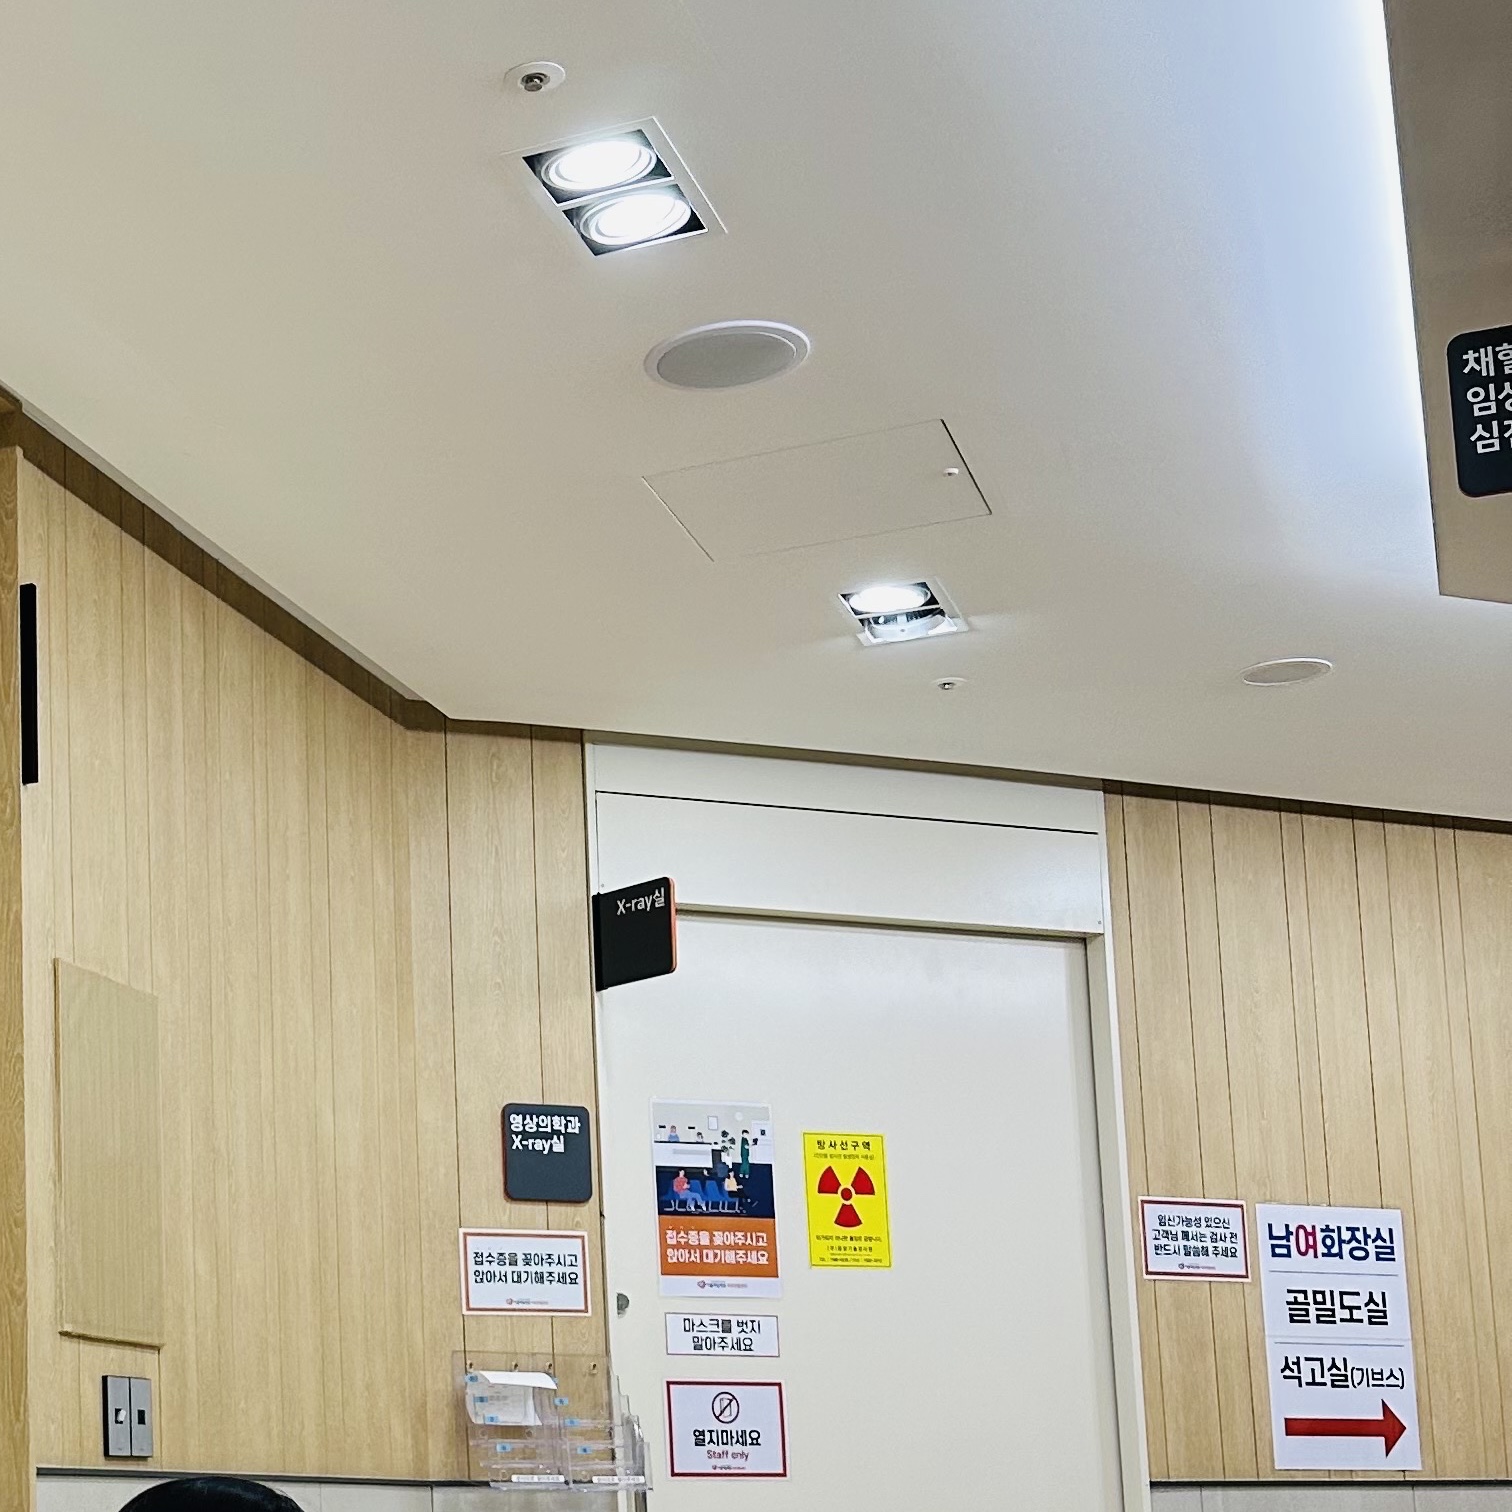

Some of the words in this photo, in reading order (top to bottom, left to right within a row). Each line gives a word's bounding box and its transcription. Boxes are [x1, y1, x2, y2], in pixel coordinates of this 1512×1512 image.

[616, 887, 665, 915] X-ray실
[509, 1114, 581, 1134] 영상의학과
[511, 1134, 565, 1154] X-ray실
[1229, 1231, 1238, 1244] 전
[1267, 1223, 1396, 1262] 남여화장실
[473, 1251, 518, 1266] 접수증을
[521, 1253, 578, 1267] 꽂아주시고
[1154, 1243, 1181, 1256] 반드시
[1212, 1245, 1238, 1258] 주세요
[511, 1270, 579, 1285] 대기해주세요
[1285, 1288, 1389, 1326] 골밀도실
[683, 1317, 732, 1334] 마스크를
[736, 1319, 761, 1334] 벗지
[692, 1336, 754, 1351] 말아주세요
[693, 1429, 761, 1447] 열지마세요
[707, 1449, 729, 1460] Staff
[731, 1450, 750, 1462] only
